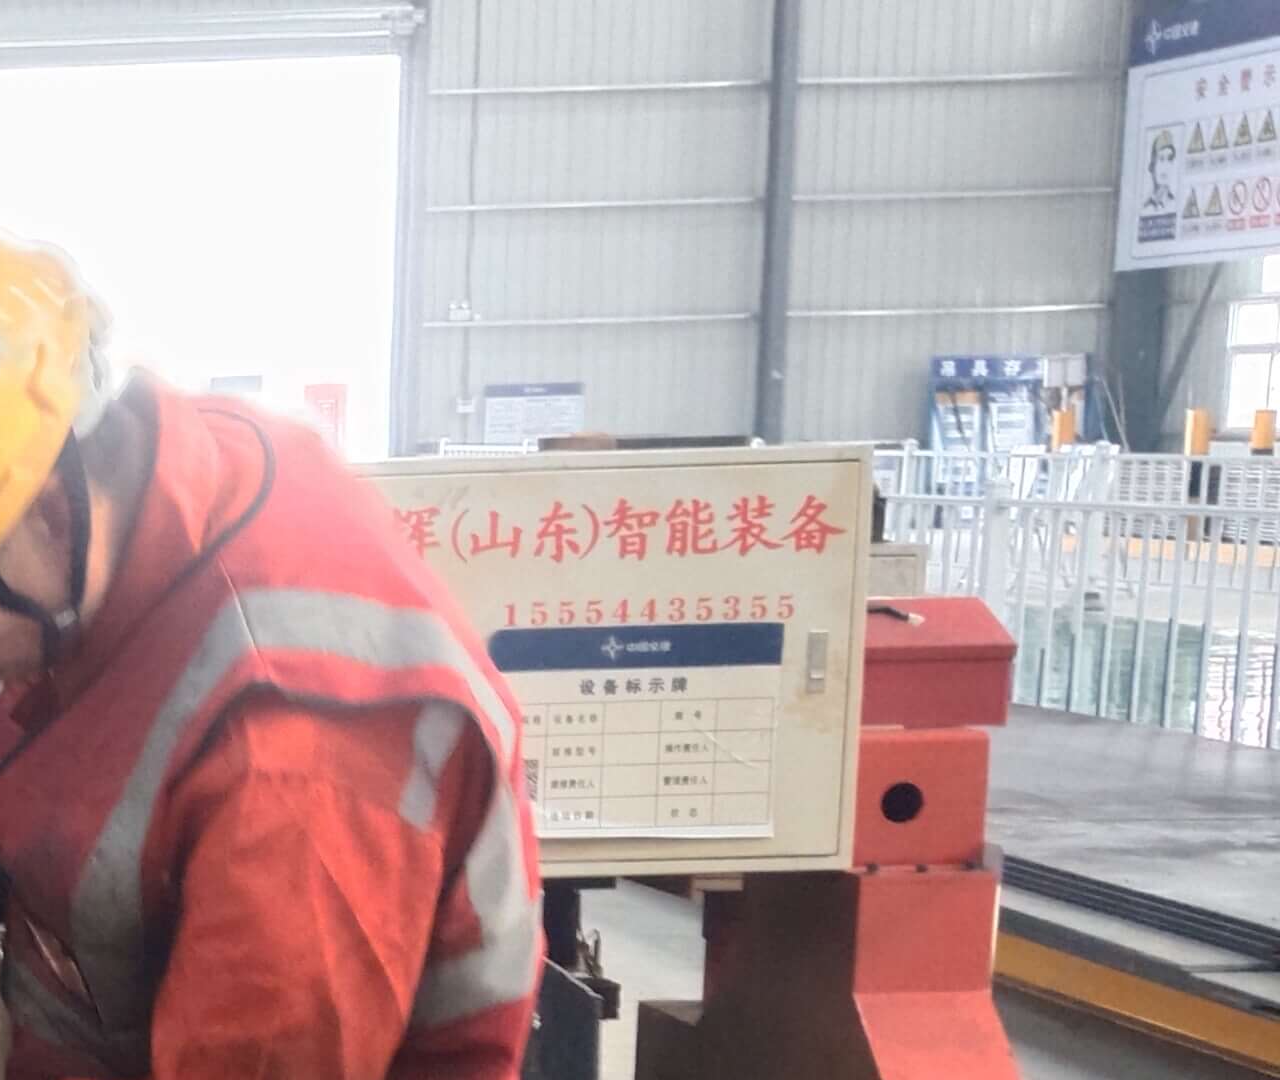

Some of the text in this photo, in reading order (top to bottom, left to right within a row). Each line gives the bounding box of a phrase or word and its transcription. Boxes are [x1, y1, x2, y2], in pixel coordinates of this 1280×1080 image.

[940, 359, 1044, 378] 吊具存
[503, 593, 795, 627] 15554435355
[578, 676, 689, 696] 设备标示牌
